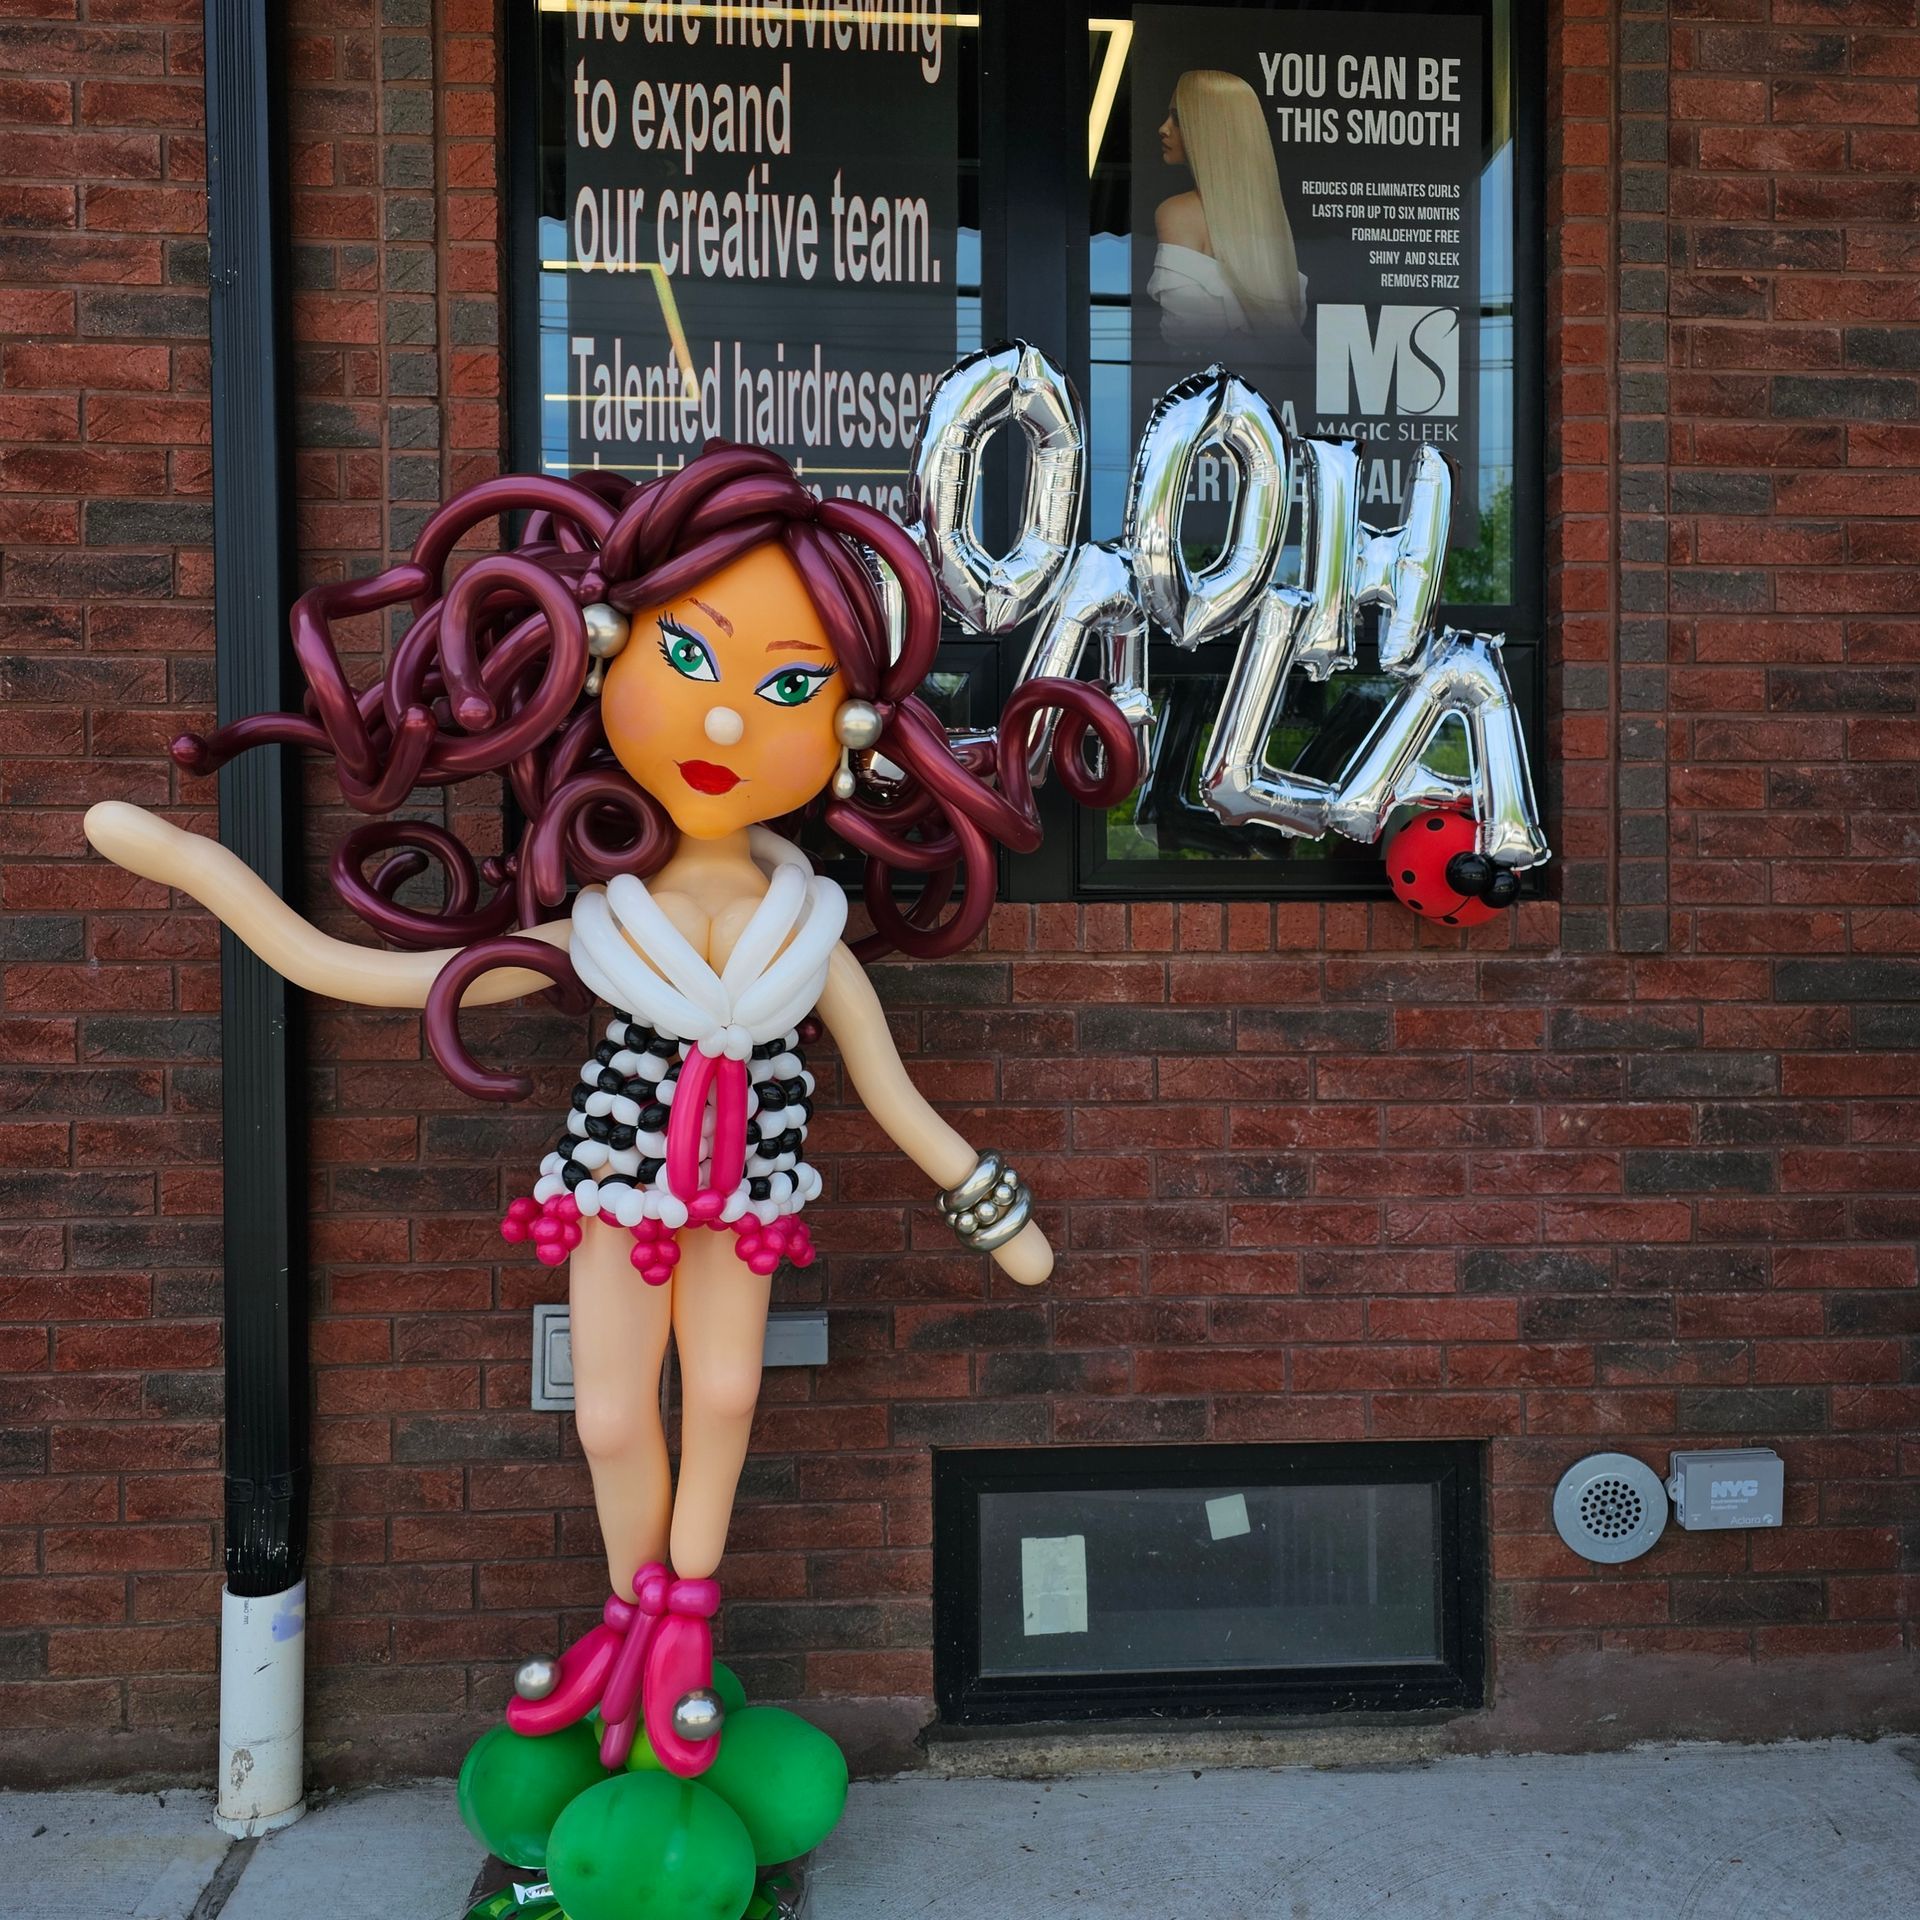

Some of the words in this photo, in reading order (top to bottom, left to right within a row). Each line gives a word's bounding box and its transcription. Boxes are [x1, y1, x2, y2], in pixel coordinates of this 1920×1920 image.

[1258, 52, 1327, 98] YOU
[1337, 54, 1407, 100] CAN
[1418, 57, 1461, 102] BE
[574, 56, 617, 149] to
[632, 63, 791, 175] expand
[1276, 107, 1339, 144] THIS
[1347, 108, 1460, 147] SMOOTH
[1302, 181, 1348, 196] REDUCES
[1350, 182, 1364, 196] OR
[1366, 182, 1426, 198] ELIMINATES
[1428, 184, 1460, 199] CURLS
[1312, 203, 1344, 218] LASTS
[1346, 204, 1366, 219] FOR
[1367, 205, 1381, 219] UP
[1383, 205, 1396, 220] TO
[1398, 206, 1415, 220] SIX
[1417, 206, 1460, 221] MONTHS
[574, 185, 644, 274] our
[657, 163, 818, 281] creative
[831, 168, 941, 283] team.
[1351, 227, 1433, 243] FORMALDEHYDE
[1434, 229, 1460, 244] FREE
[1369, 250, 1400, 265] SHINY
[1405, 251, 1426, 266] AND
[1428, 252, 1460, 266] SLEEK
[1381, 273, 1429, 288] REMOVES
[1431, 274, 1460, 289] FRIZZ
[1316, 303, 1460, 417] MS
[571, 336, 721, 444] Talented
[1316, 421, 1391, 441] MAGIC
[1398, 422, 1460, 442] SLEEK
[1711, 1480, 1759, 1498] NYC
